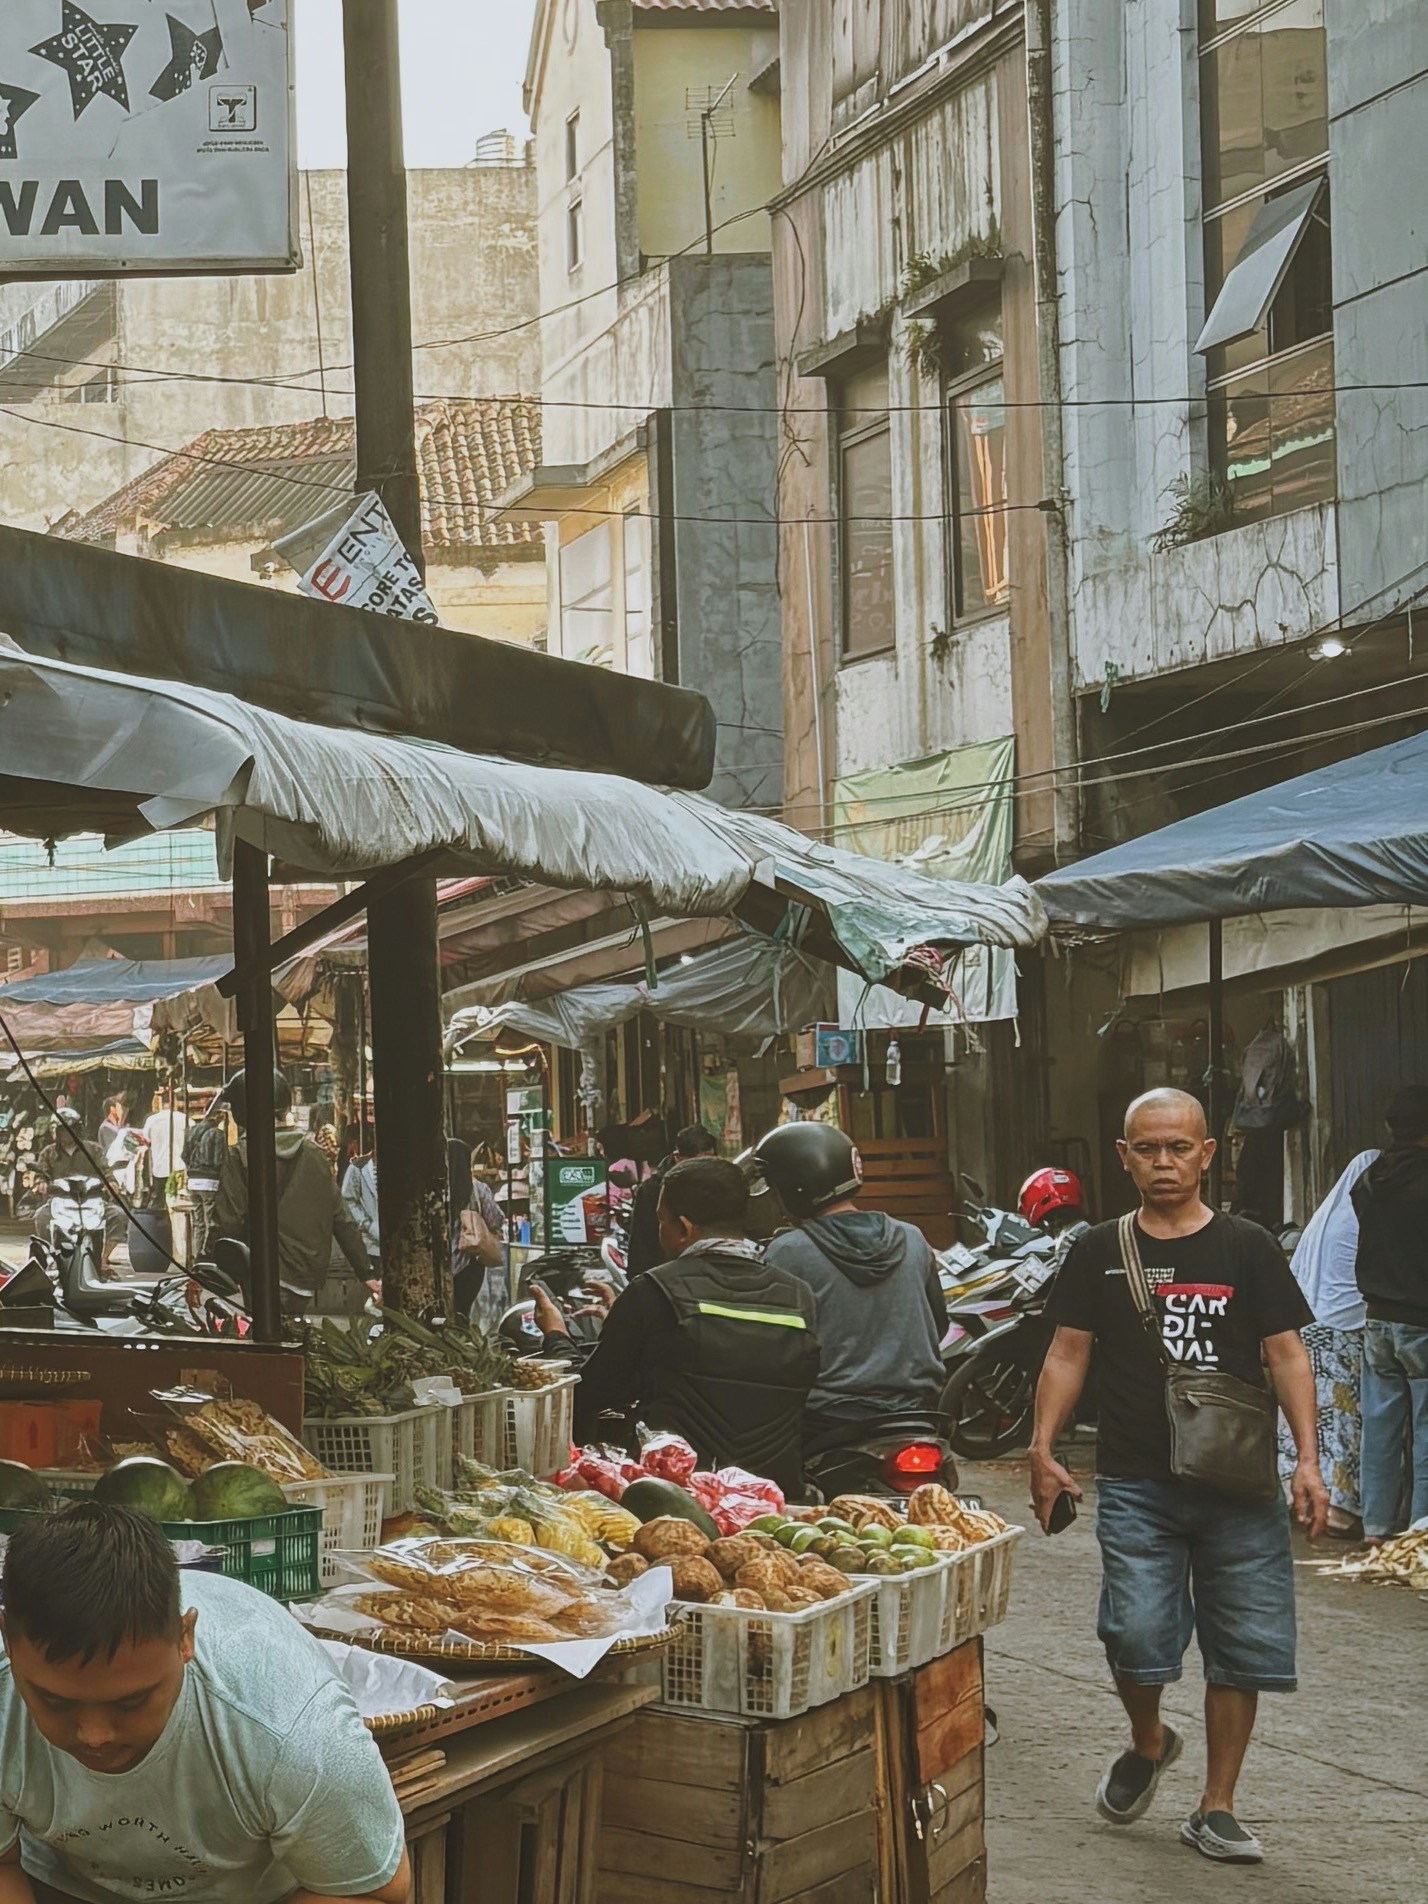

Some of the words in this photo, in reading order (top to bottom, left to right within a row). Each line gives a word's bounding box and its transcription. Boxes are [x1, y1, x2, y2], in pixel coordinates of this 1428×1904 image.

[61, 31, 104, 93] STAR
[75, 24, 116, 82] LITTLE
[1165, 1294, 1228, 1316] CAR
